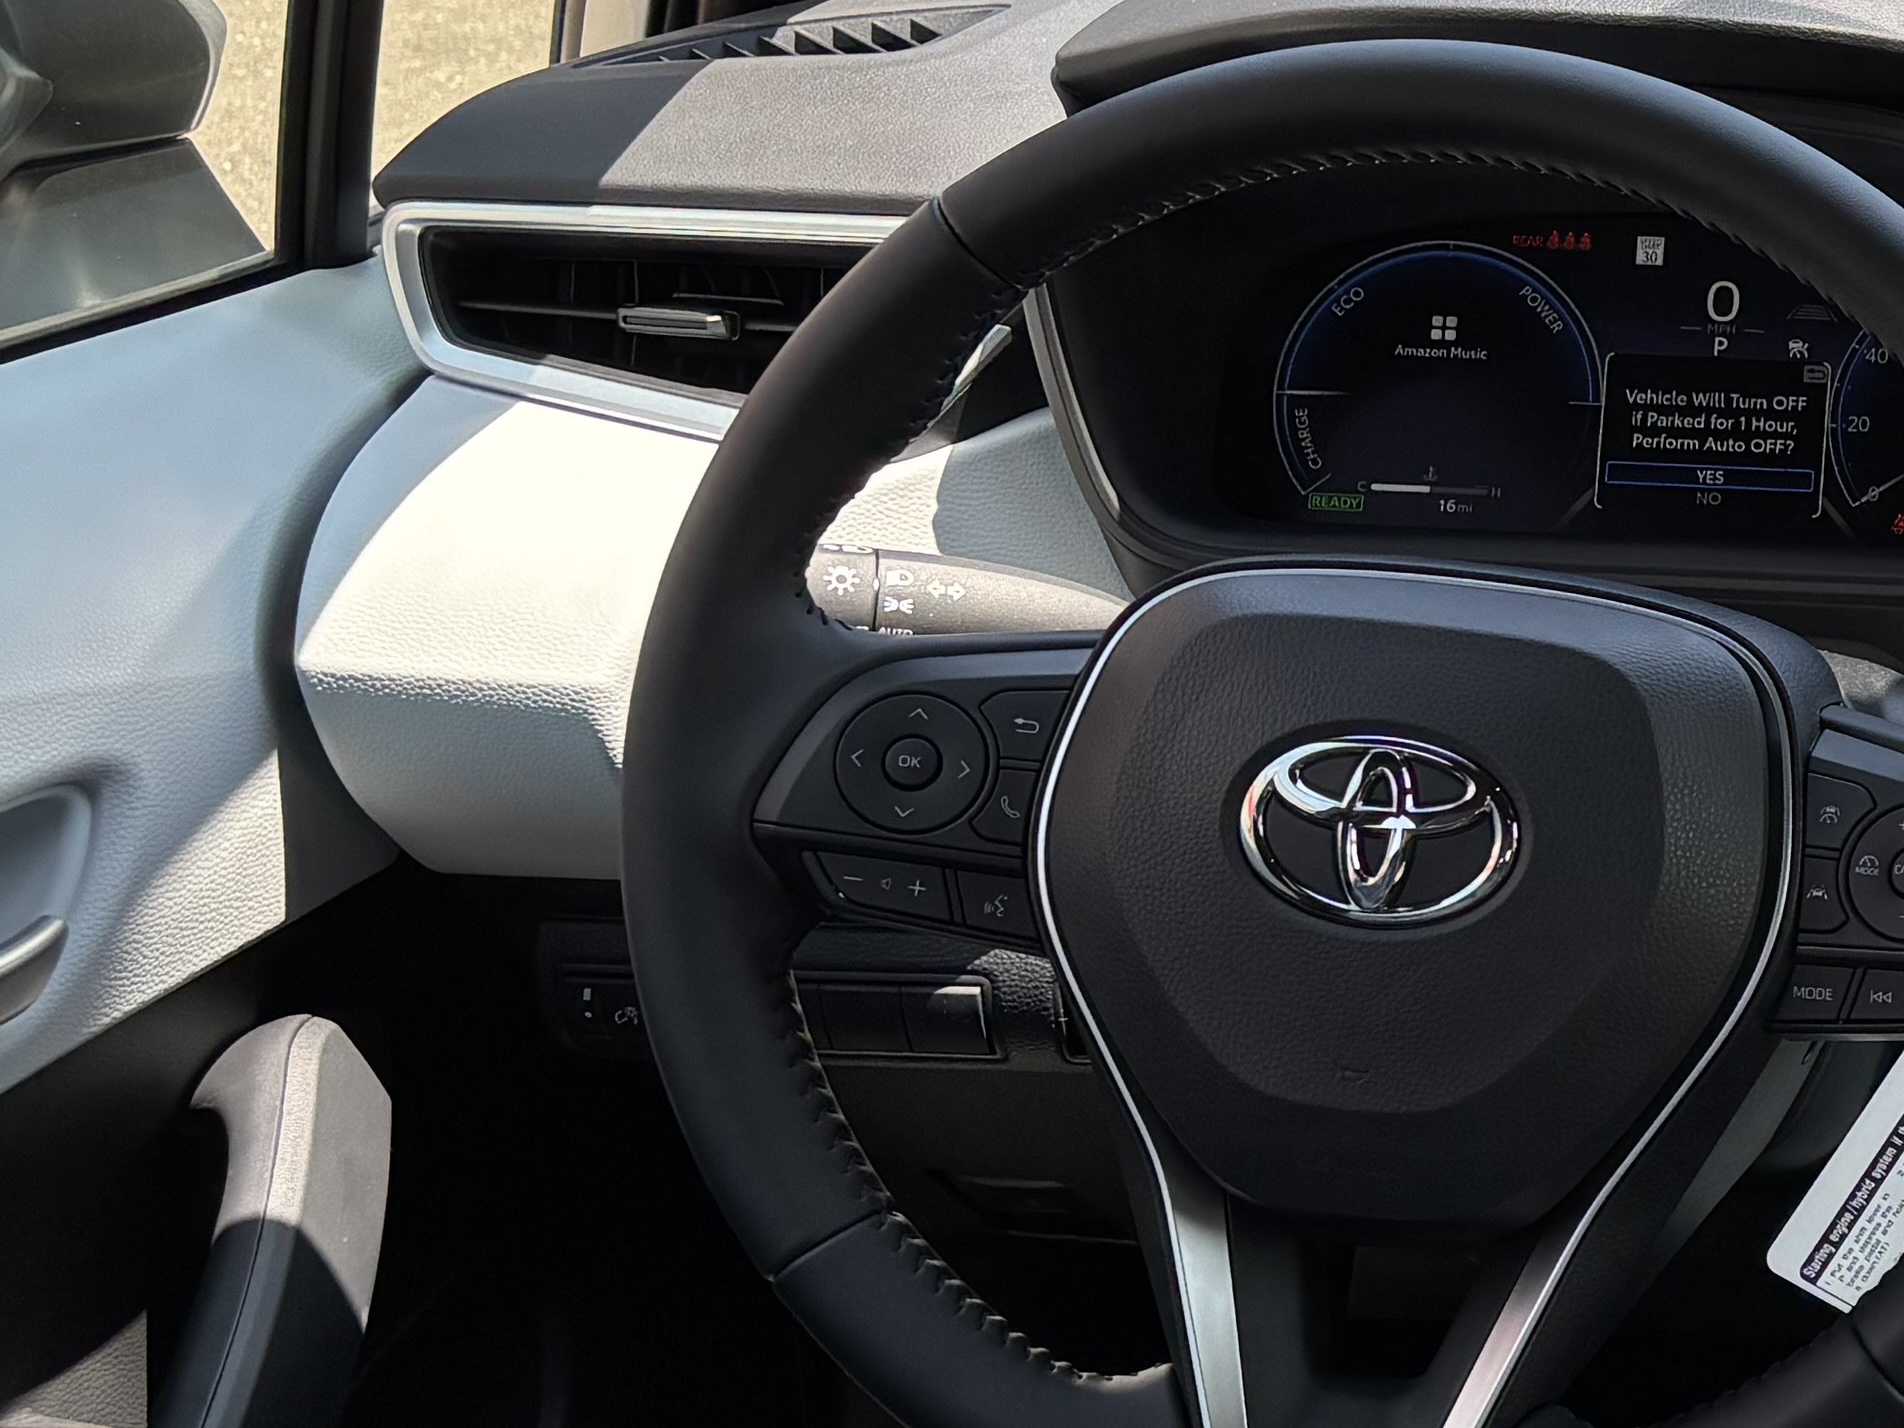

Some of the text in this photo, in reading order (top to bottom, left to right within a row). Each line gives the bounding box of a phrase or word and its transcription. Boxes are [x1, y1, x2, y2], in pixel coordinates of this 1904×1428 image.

[1512, 235, 1544, 248] REAR
[1641, 251, 1658, 264] 30
[1331, 286, 1366, 318] ECO
[1517, 285, 1565, 335] POWER
[1706, 280, 1741, 323] 0
[1706, 323, 1738, 335] MPH
[1395, 344, 1488, 361] Amazon Music
[1713, 336, 1729, 357] P
[1864, 347, 1890, 365] 40
[1626, 388, 1808, 411] Vehicle Will Turn OFF
[1631, 410, 1643, 426] if
[1647, 412, 1706, 429] Parked
[1710, 414, 1735, 430] for
[1751, 416, 1799, 436] Hour,
[1847, 416, 1871, 433] 20
[1295, 407, 1323, 471] CHARGE
[1632, 433, 1795, 455] Perform Auto OFF?
[1696, 469, 1725, 485] YES
[1311, 494, 1361, 511] READY
[1696, 491, 1722, 506] NO
[898, 754, 922, 769] OK
[1855, 866, 1881, 877] MODE
[1792, 985, 1834, 1001] MODE
[1803, 1244, 1835, 1278] Starting
[1871, 1149, 1898, 1180] system
